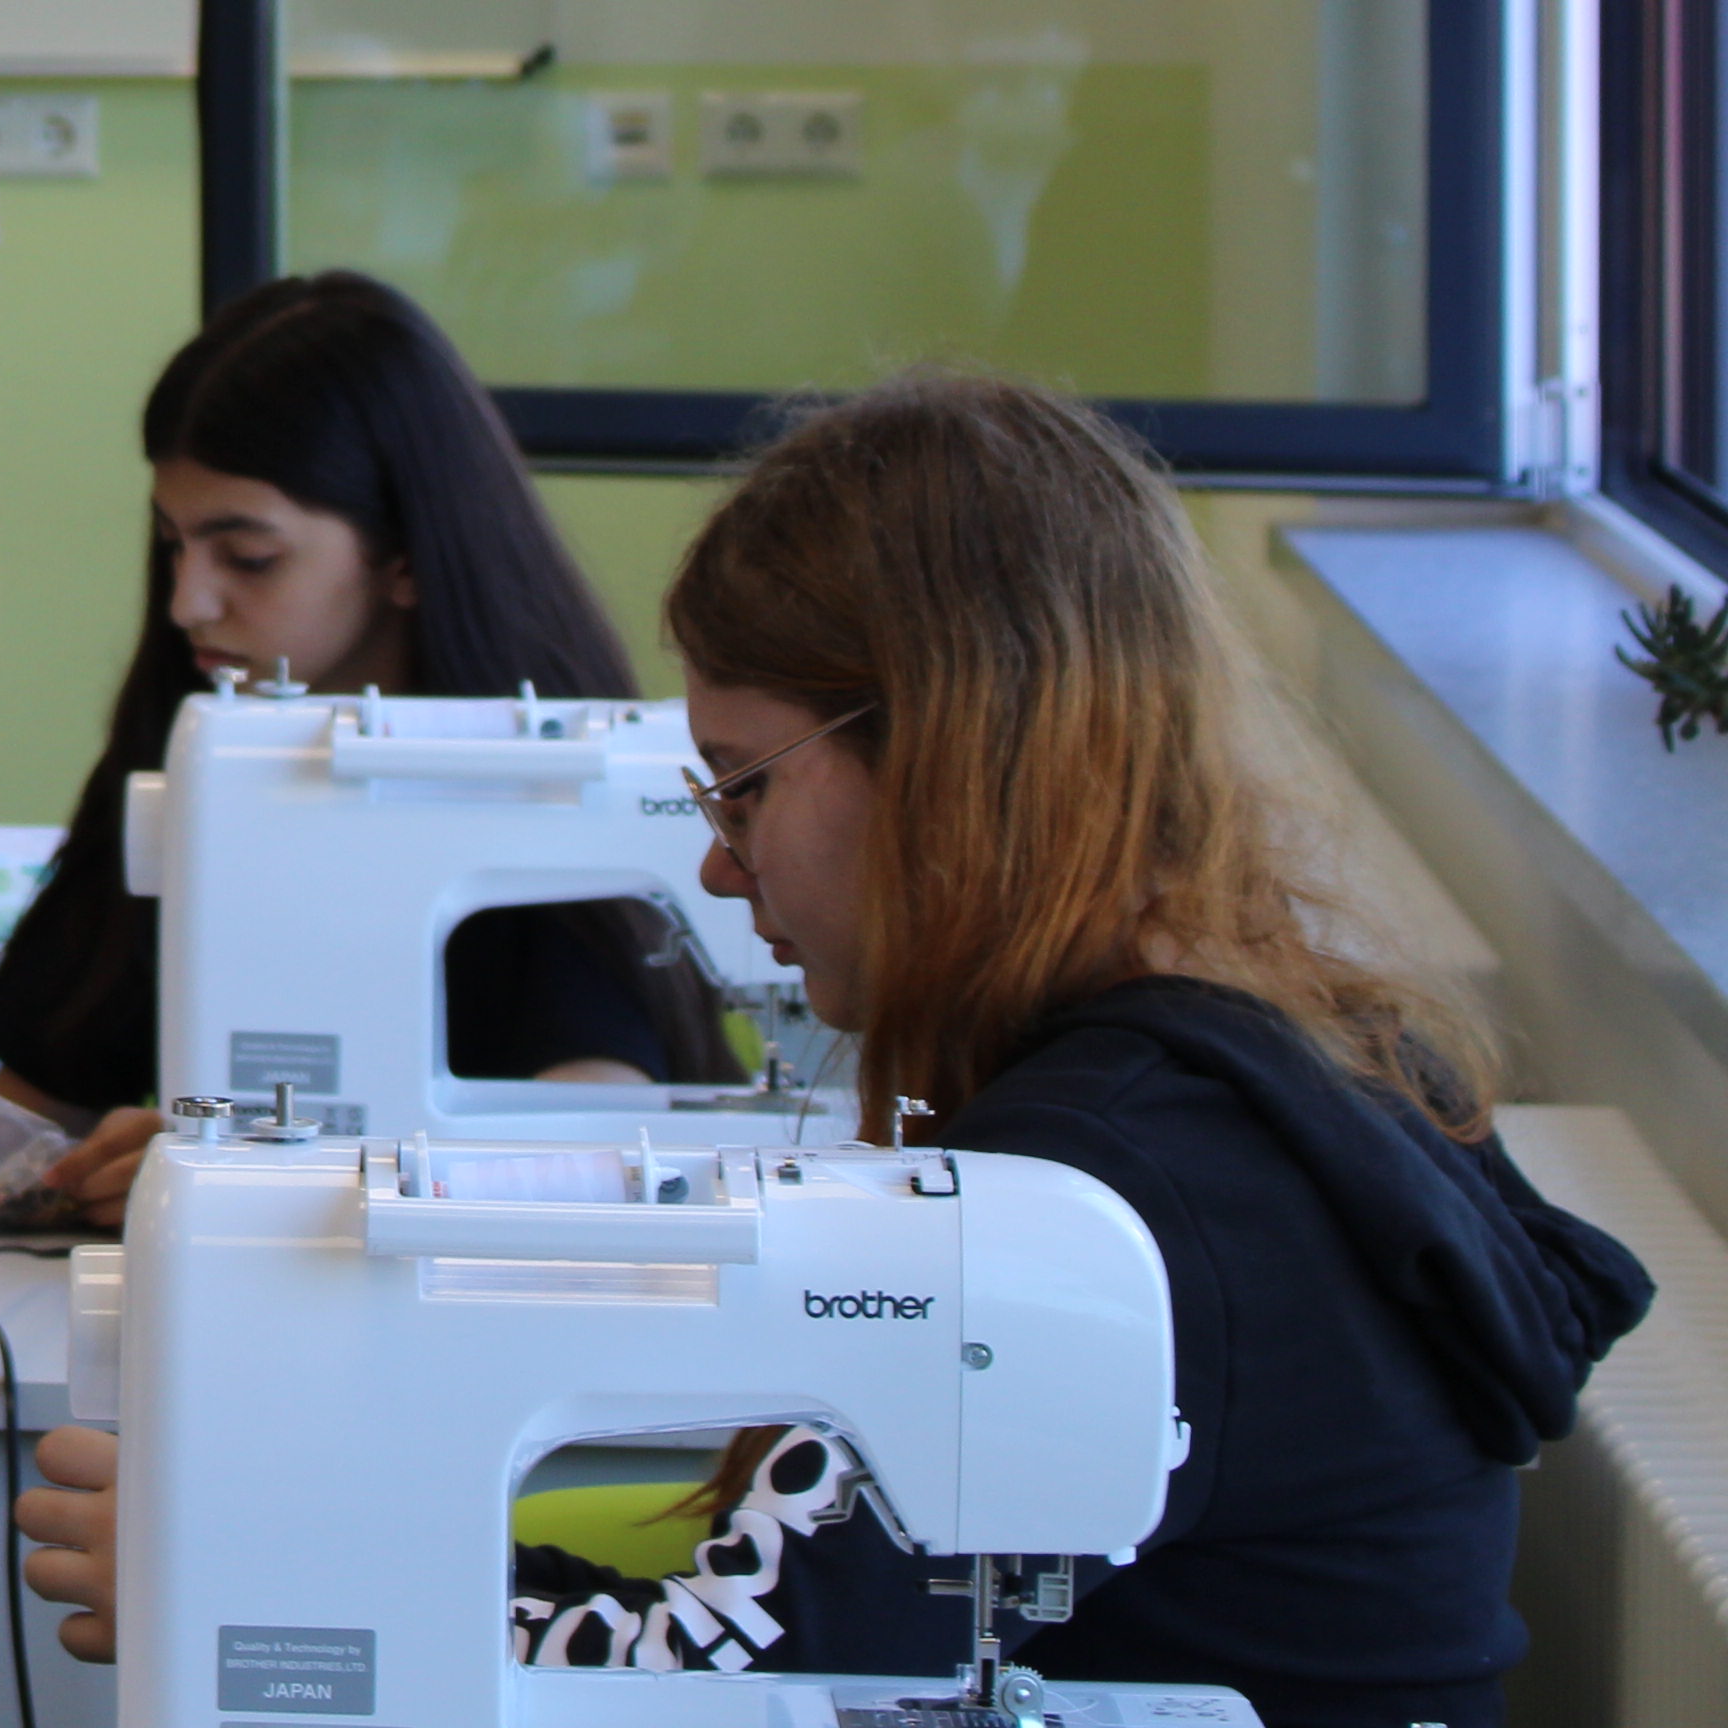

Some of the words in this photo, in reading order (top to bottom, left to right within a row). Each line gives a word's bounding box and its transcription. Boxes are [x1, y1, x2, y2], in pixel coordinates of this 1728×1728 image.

[804, 1289, 935, 1319] brother
[233, 1641, 270, 1653] Quality
[274, 1643, 282, 1652] &
[284, 1643, 345, 1656] Technology
[348, 1645, 361, 1656] by
[226, 1658, 278, 1670] BROTHER
[263, 1683, 333, 1700] JAPAN
